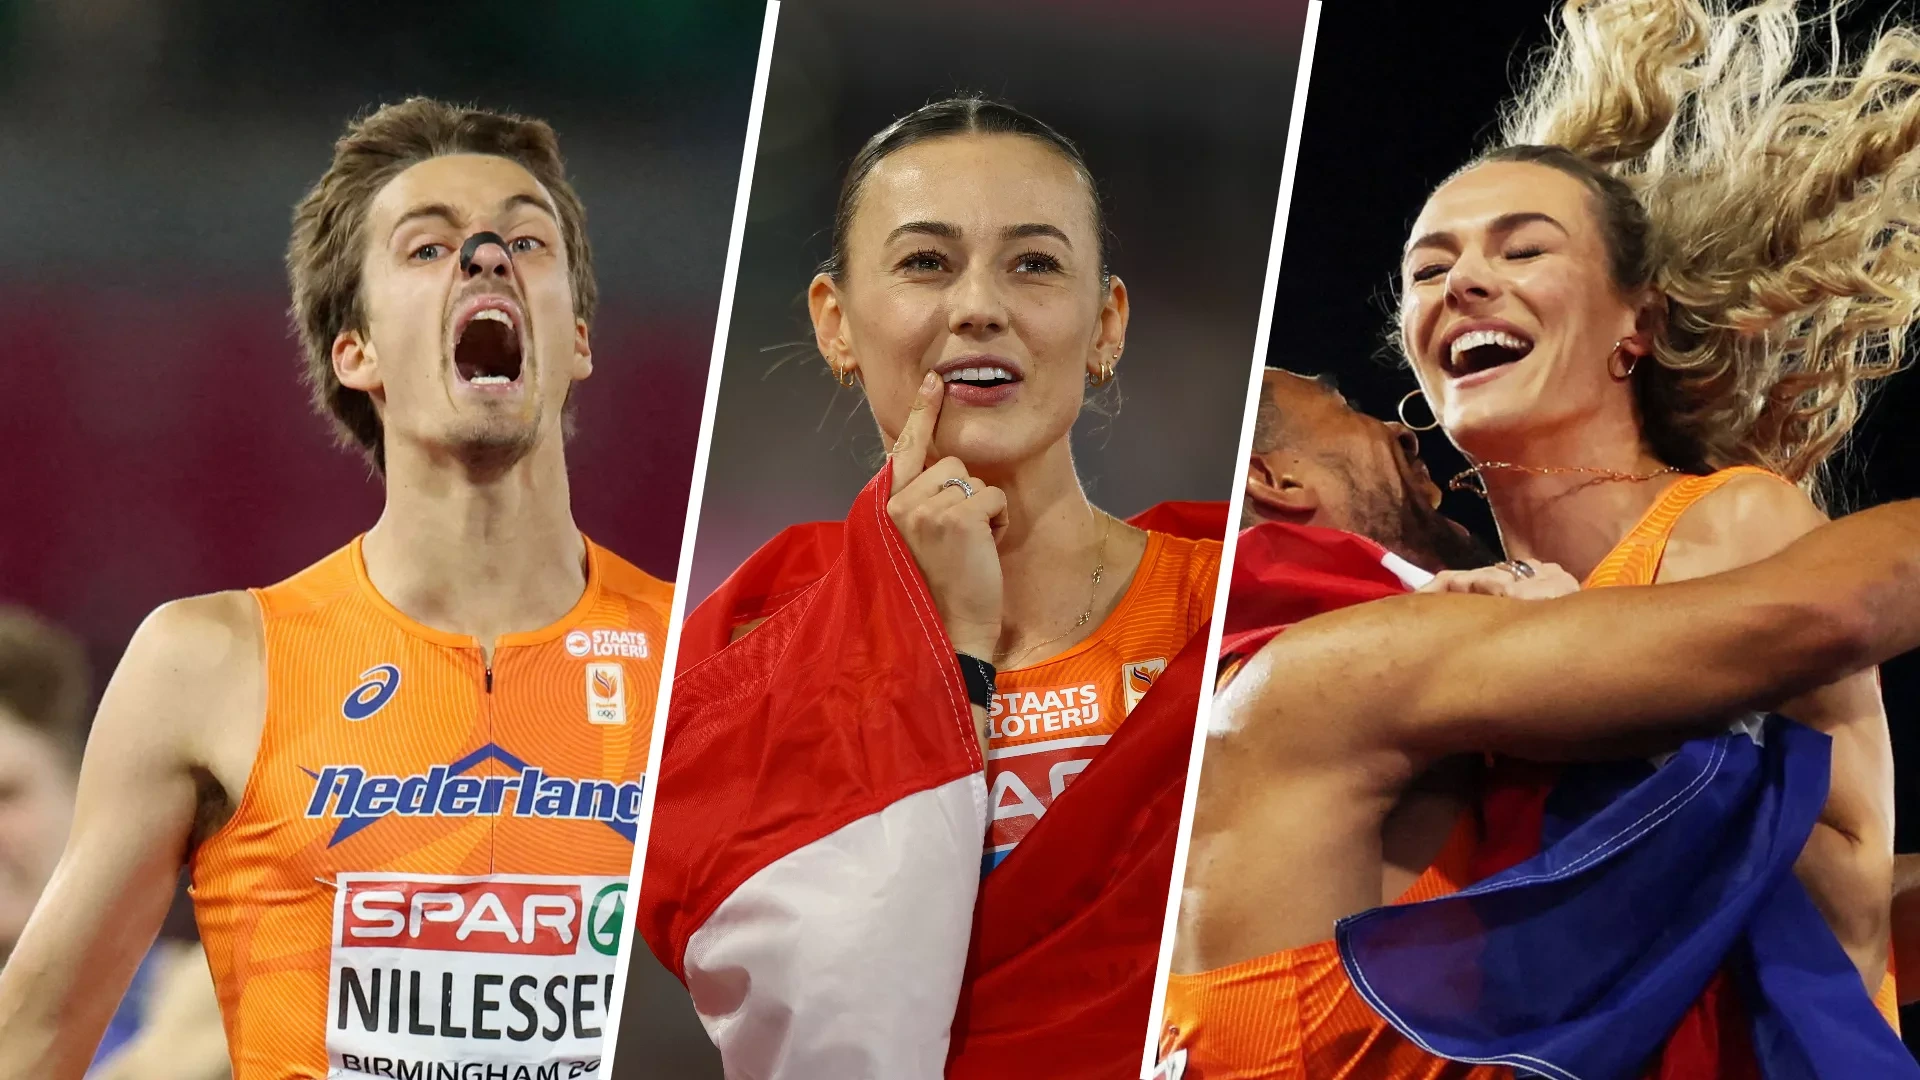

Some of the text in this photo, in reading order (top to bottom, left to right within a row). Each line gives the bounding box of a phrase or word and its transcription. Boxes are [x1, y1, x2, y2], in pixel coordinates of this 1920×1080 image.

[592, 630, 646, 645] STAATS
[990, 684, 1098, 716] STAATS
[349, 892, 578, 945] SPAR
[342, 1053, 560, 1080] BIRMINGHAM
